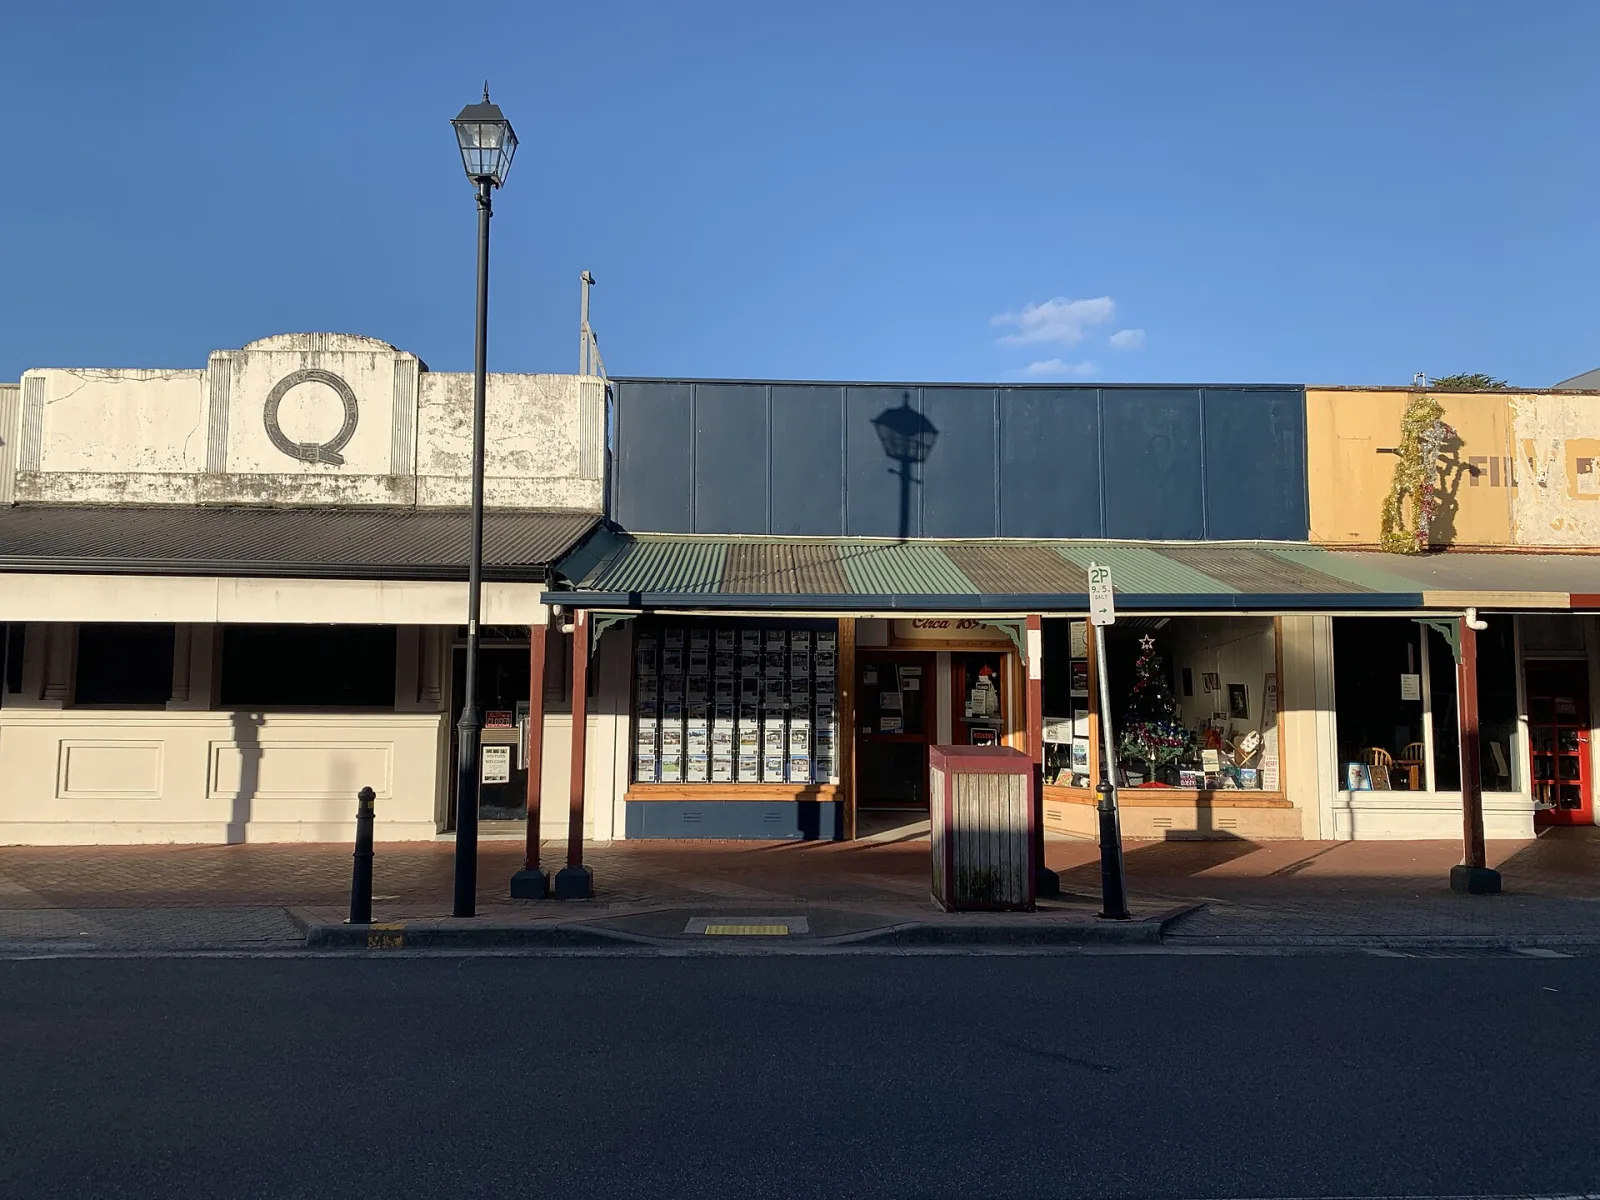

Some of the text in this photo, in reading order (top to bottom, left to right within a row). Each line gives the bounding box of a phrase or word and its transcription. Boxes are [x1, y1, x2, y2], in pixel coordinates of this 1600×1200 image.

[1091, 569, 1109, 583] 2P
[912, 618, 952, 629] Circa
[488, 717, 510, 726] CLOSED
